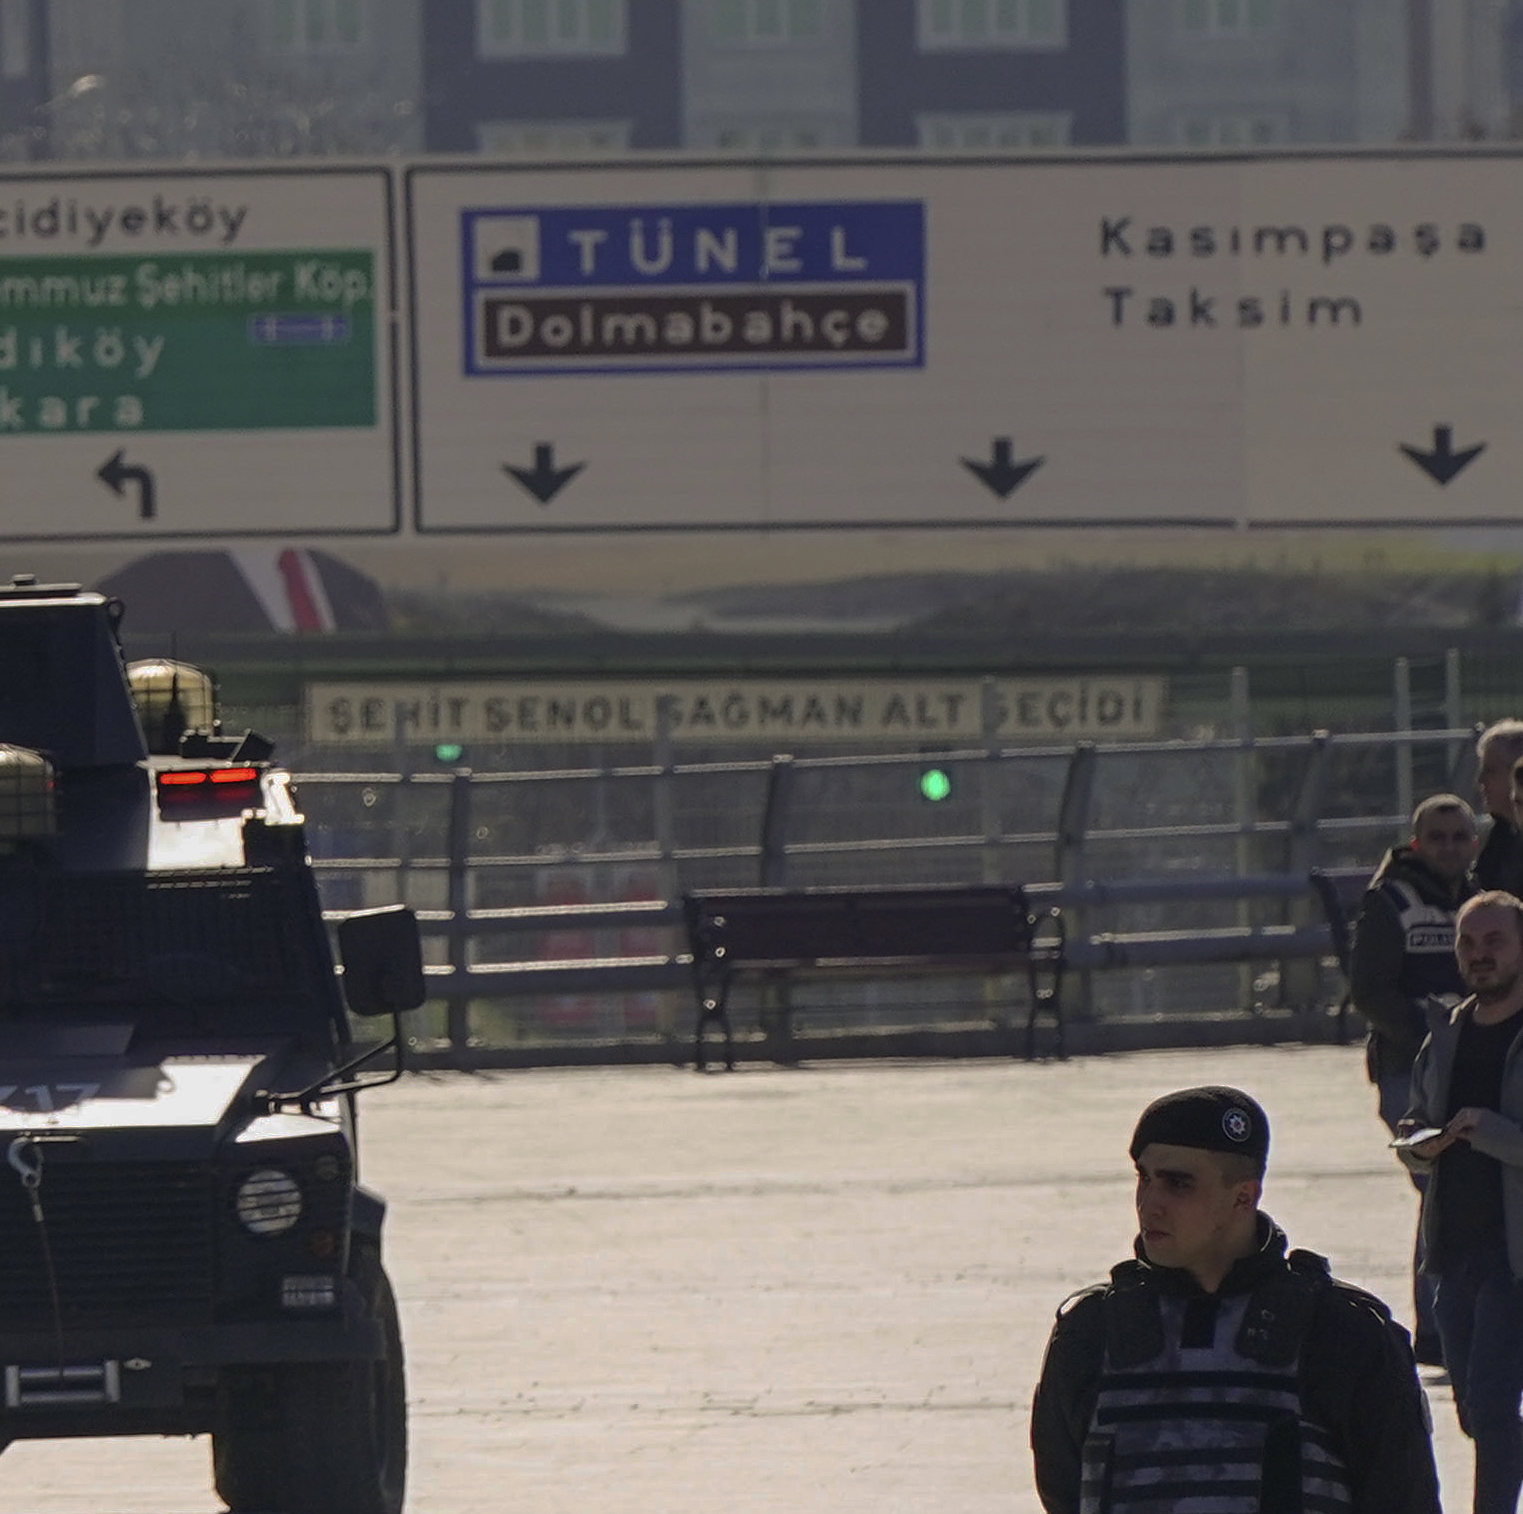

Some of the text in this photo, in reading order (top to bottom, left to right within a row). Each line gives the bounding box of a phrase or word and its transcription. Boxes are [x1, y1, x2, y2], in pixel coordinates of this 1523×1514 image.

[568, 219, 867, 276] TÜNEL
[1100, 216, 1486, 266] Kasımpaşa
[498, 304, 890, 348] Dolmabahçe
[1103, 286, 1362, 329] Taksim
[882, 692, 967, 727] ALT
